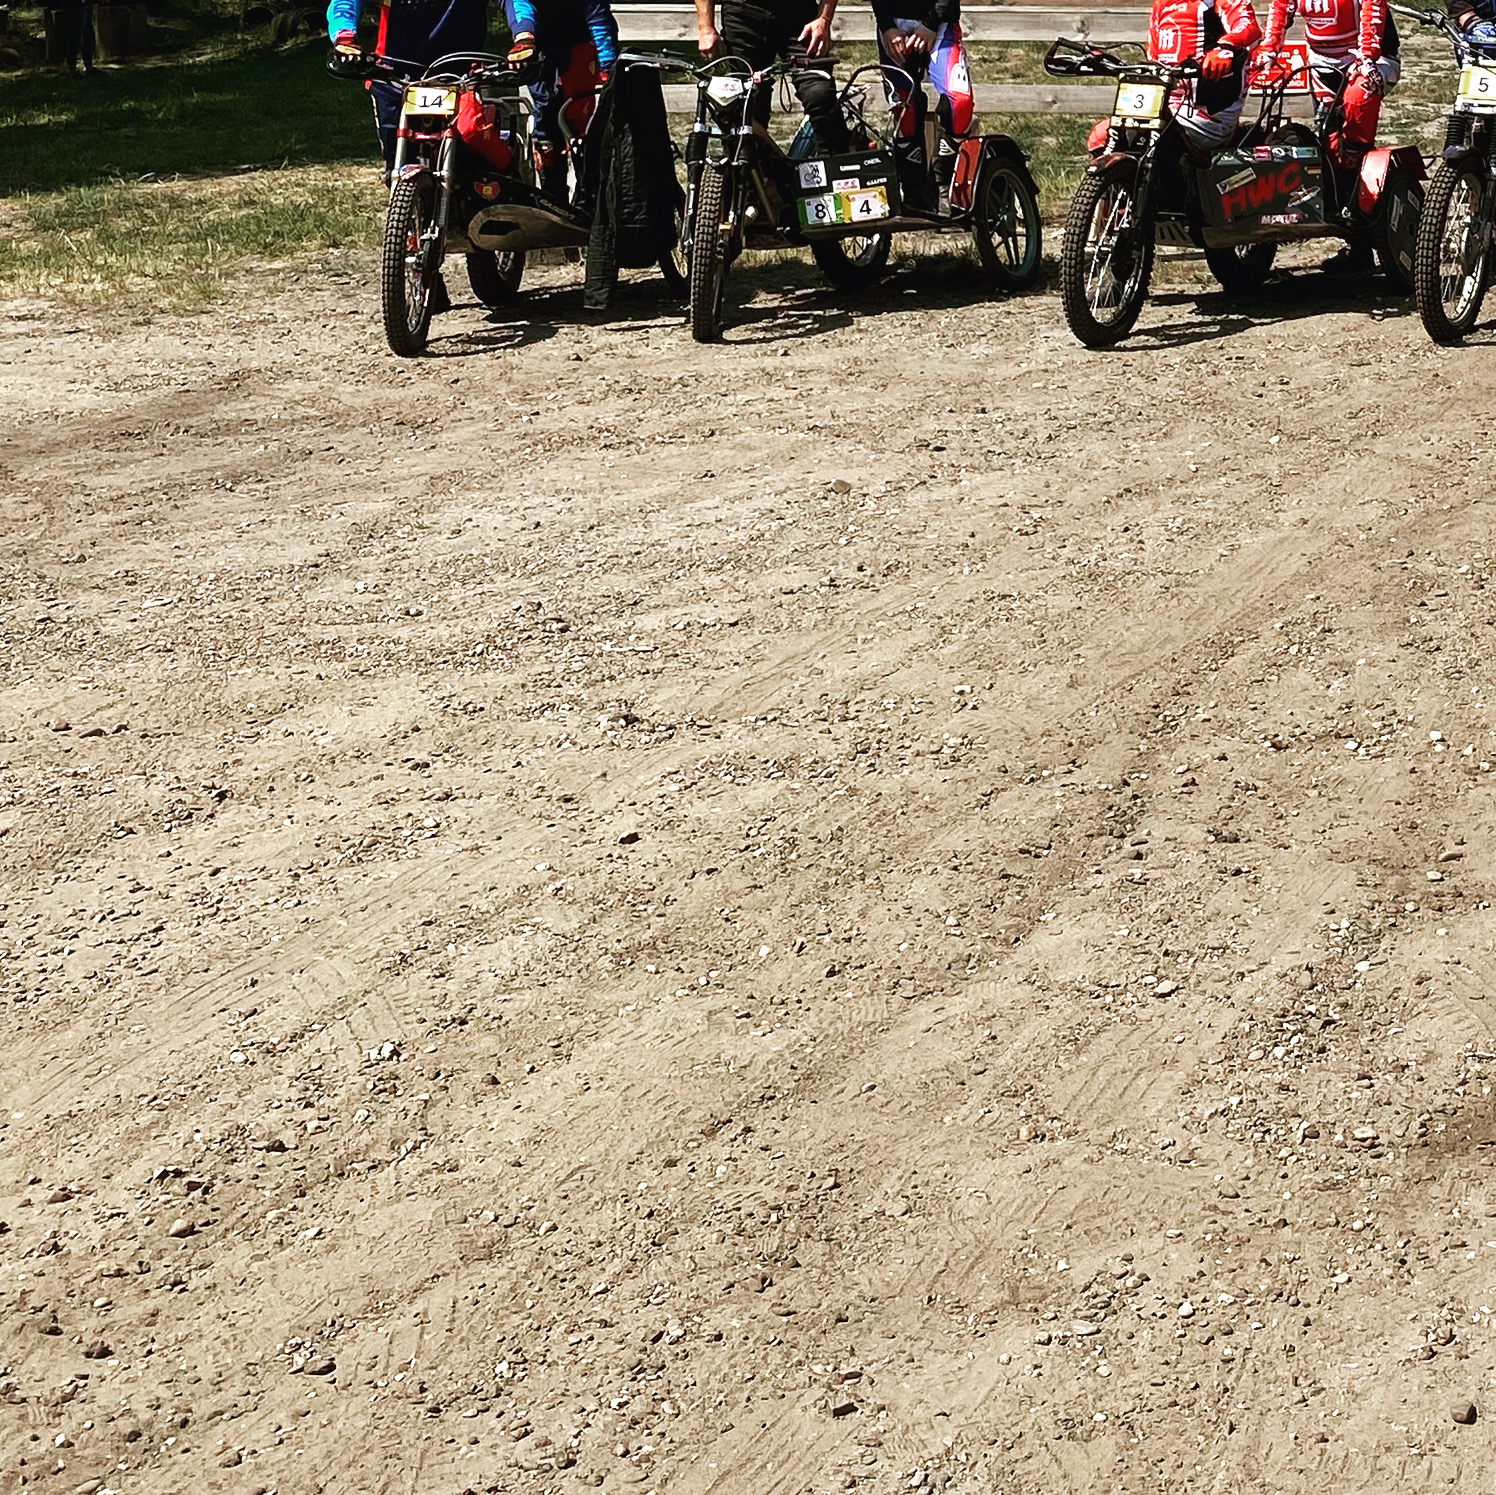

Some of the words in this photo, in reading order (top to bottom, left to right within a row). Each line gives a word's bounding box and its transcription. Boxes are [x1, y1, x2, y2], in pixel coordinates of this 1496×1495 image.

[1478, 77, 1489, 92] 5
[419, 94, 443, 109] 14
[1133, 94, 1144, 109] 3
[814, 203, 826, 219] 8
[859, 199, 872, 215] 4
